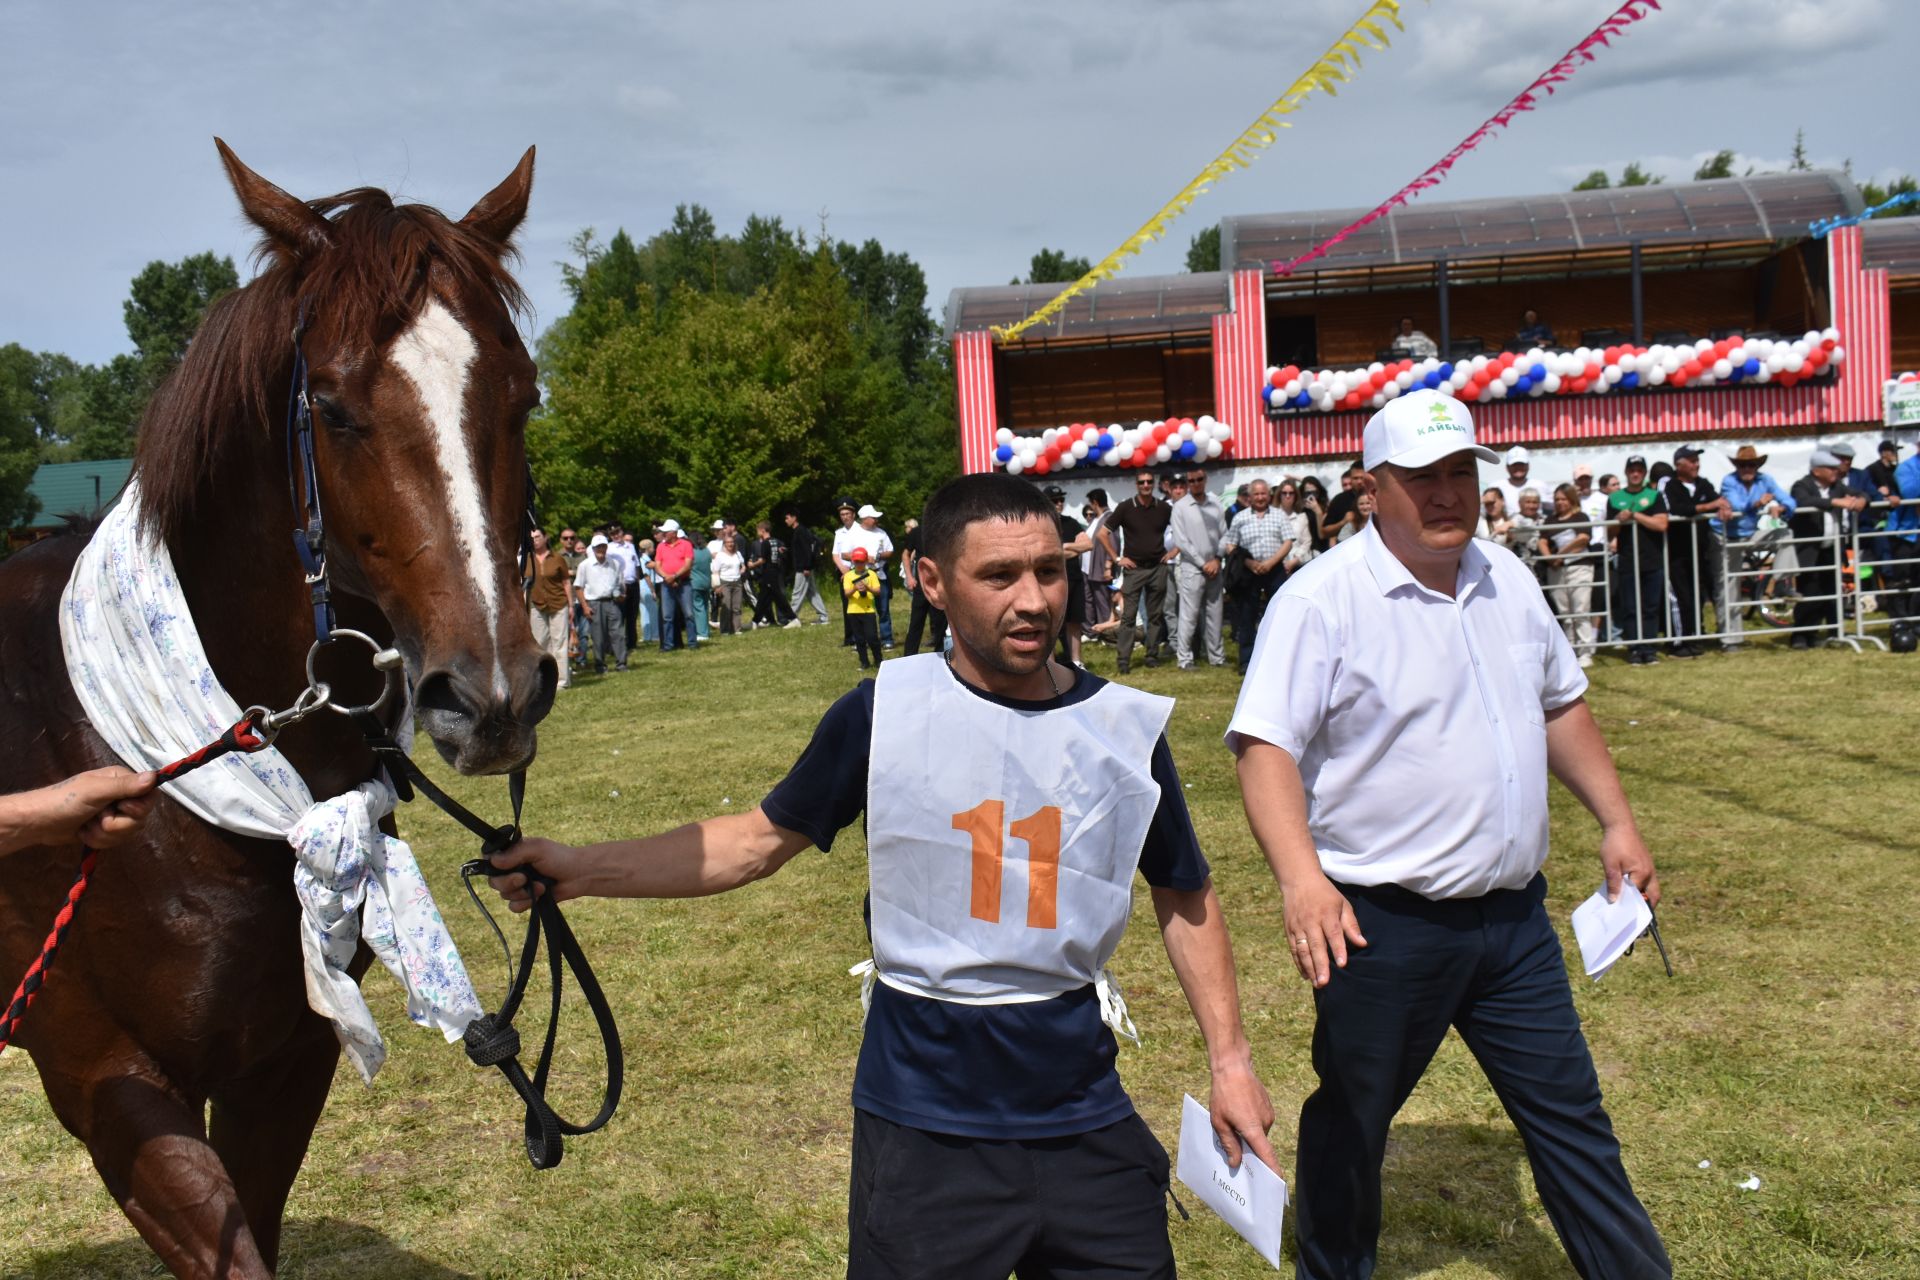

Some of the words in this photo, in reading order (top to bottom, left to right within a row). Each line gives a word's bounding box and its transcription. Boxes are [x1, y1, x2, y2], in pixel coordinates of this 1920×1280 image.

[1417, 422, 1467, 436] КАЙБЫЧ
[952, 799, 1062, 929] 11
[1219, 1179, 1246, 1207] место
